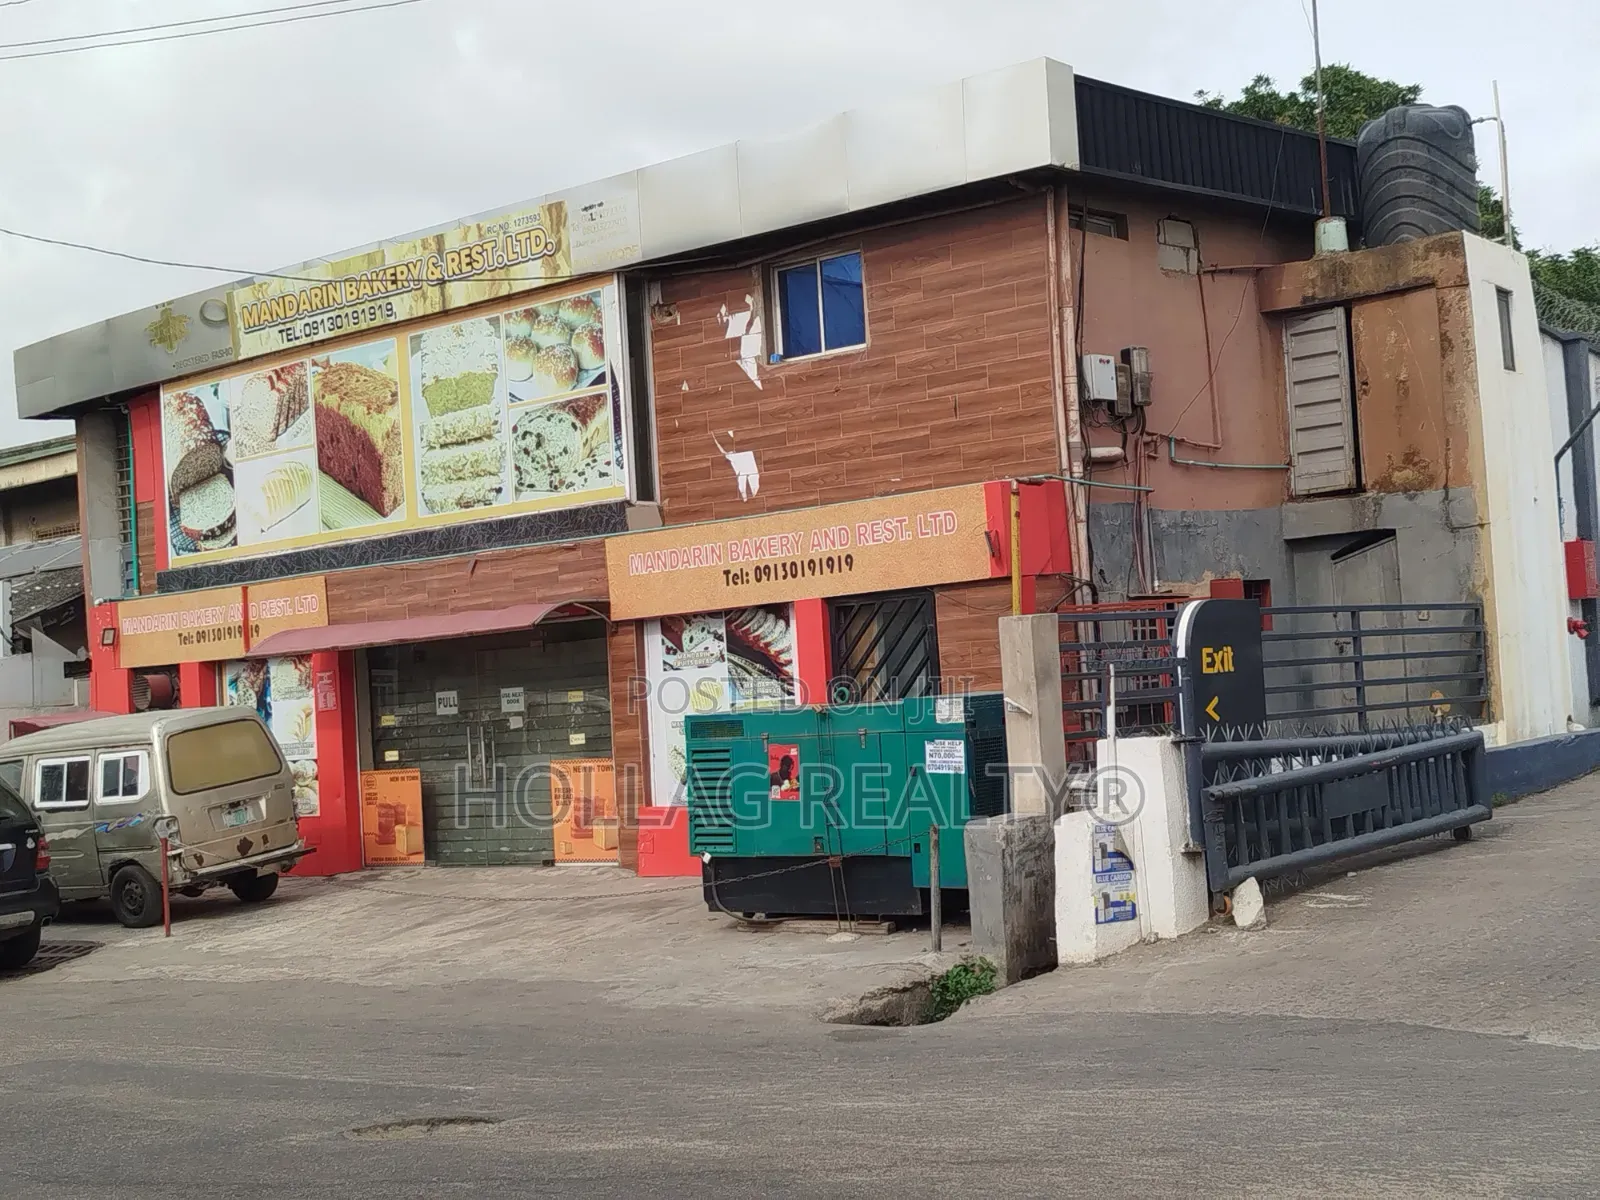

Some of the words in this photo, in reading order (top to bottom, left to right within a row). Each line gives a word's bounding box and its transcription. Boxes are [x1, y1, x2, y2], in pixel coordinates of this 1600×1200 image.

[486, 224, 497, 235] RC
[499, 221, 511, 232] NO:
[513, 212, 541, 227] 1273593
[241, 280, 342, 334] MANDARIN
[344, 255, 423, 302] BAKERY
[425, 254, 444, 284] &
[629, 543, 724, 576] MANDARIN
[728, 532, 804, 563] BAKERY
[810, 525, 851, 553] AND
[856, 516, 912, 547] REST.
[917, 510, 958, 539] LTD
[723, 567, 750, 587] Tel:
[754, 553, 854, 583] 09130191919
[122, 611, 179, 636] MANDARIN
[181, 605, 226, 628] BAKERY
[259, 598, 294, 619] REST.
[295, 594, 319, 616] LTD
[178, 631, 194, 646] Tel:
[1202, 646, 1235, 674] Exit
[438, 696, 458, 709] PULL
[573, 765, 587, 773] NEW
[596, 764, 614, 773] TOWN
